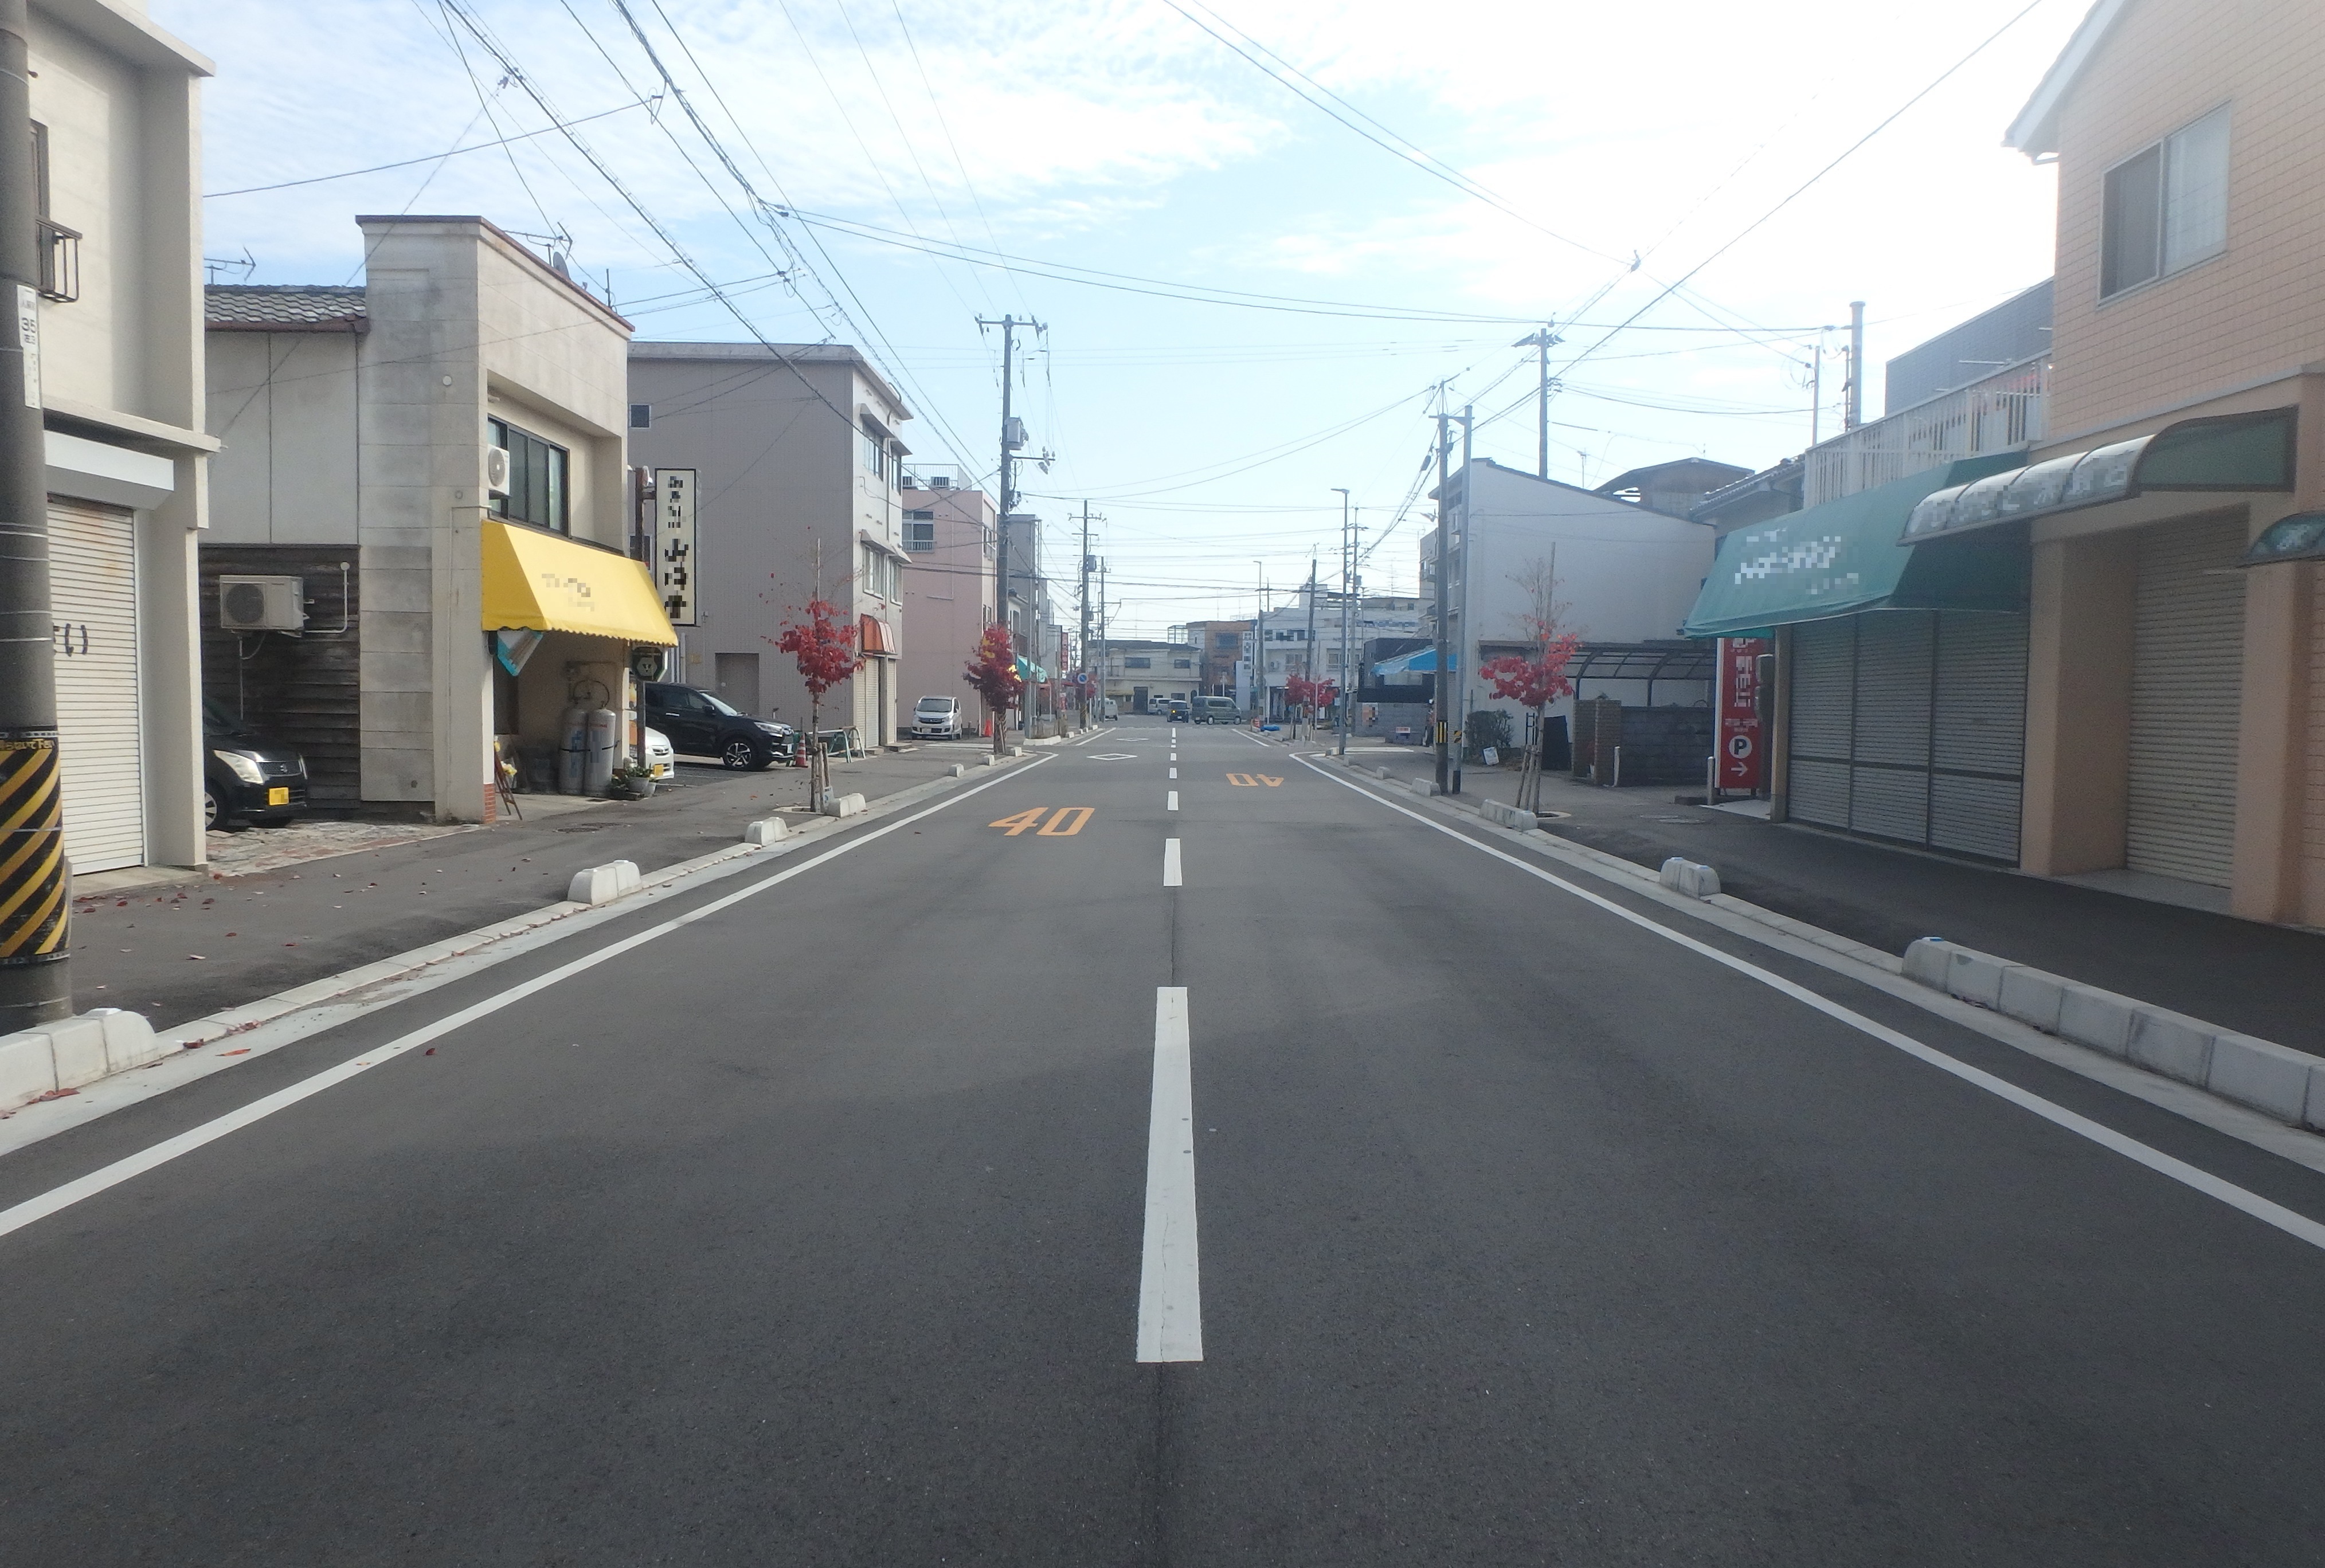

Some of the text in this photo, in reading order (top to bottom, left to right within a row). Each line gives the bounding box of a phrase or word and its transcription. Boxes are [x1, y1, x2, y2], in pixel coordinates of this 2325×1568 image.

[21, 317, 36, 334] 35
[1733, 738, 1747, 755] P
[1226, 773, 1284, 787] 40
[988, 807, 1095, 836] 40
